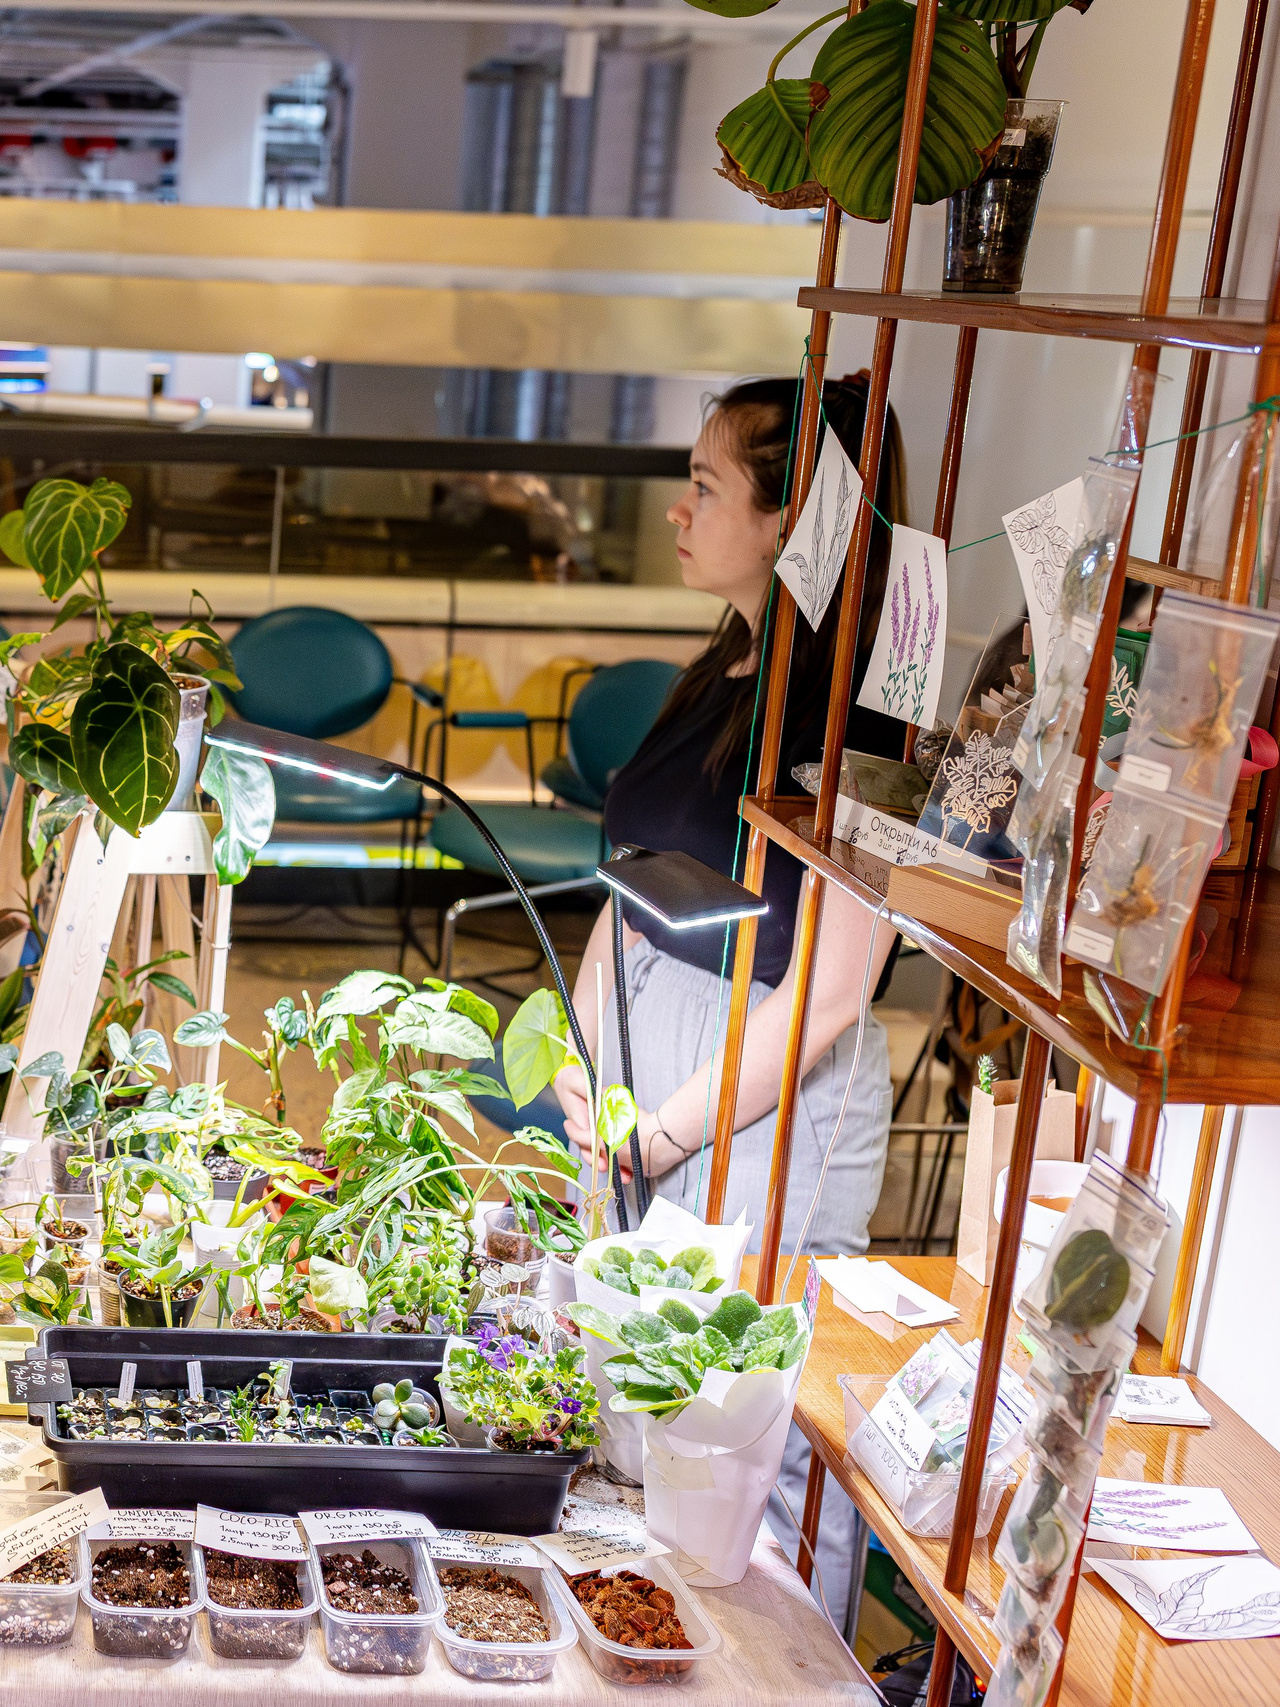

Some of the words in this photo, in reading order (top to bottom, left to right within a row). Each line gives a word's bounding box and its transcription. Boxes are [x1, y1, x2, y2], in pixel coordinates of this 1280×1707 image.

[871, 816, 920, 850] Открытки
[117, 1510, 188, 1518] UNIVERSAL
[219, 1511, 302, 1528] COCO-RICE
[314, 1510, 385, 1520] ORGANIC
[20, 1520, 89, 1561] MINERAL
[440, 1529, 496, 1543] AROID
